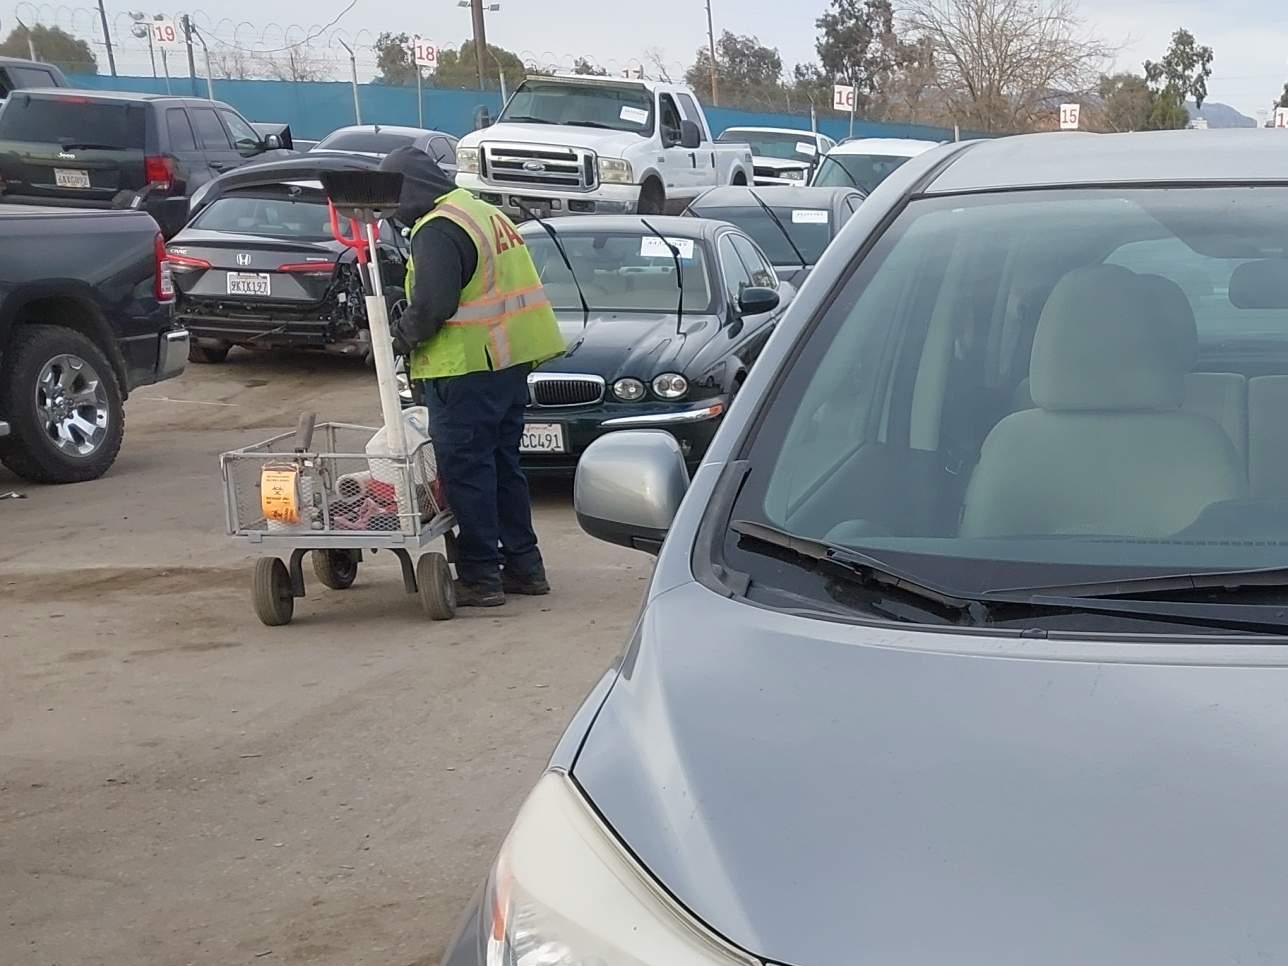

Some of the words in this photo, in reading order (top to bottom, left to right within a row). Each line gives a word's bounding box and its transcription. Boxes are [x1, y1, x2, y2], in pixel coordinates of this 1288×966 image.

[156, 25, 176, 42] 19
[416, 44, 437, 61] 18
[835, 91, 855, 106] 16
[1061, 109, 1077, 124] 15
[520, 433, 562, 449] CC491
